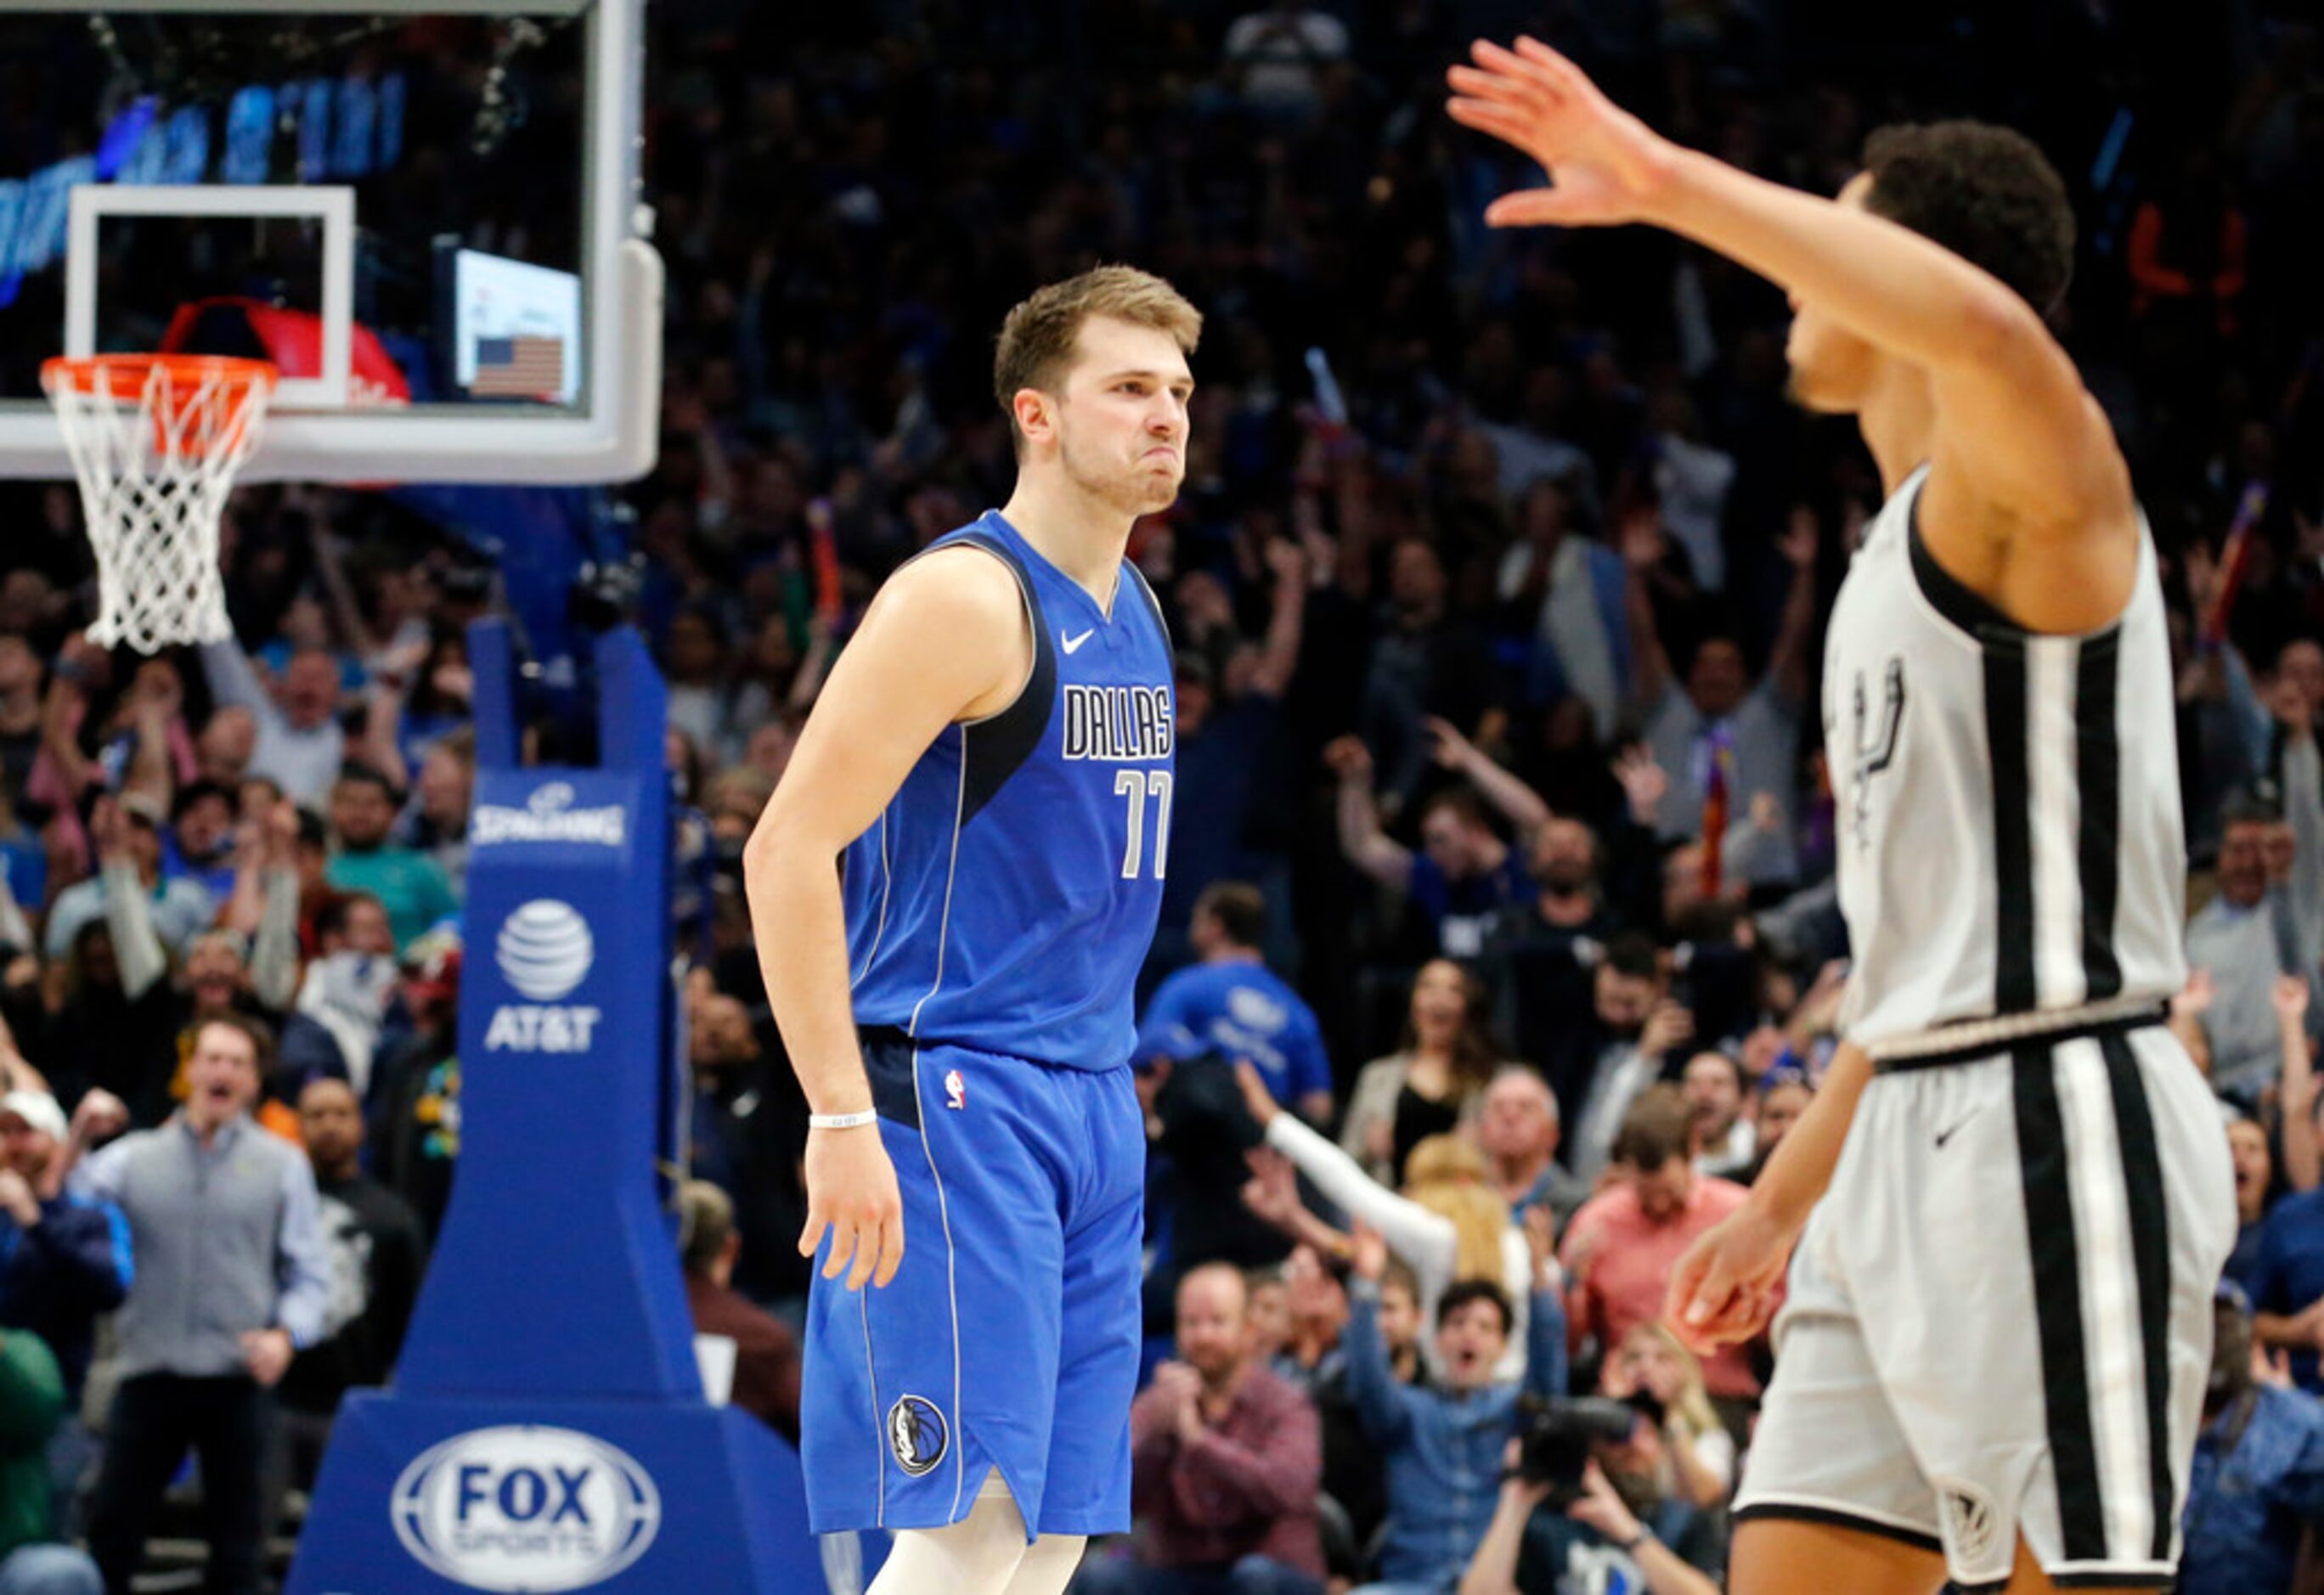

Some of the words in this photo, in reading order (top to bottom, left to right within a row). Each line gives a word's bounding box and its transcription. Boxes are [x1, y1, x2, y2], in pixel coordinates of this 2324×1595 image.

[1063, 685, 1172, 760] DALLAS
[471, 805, 624, 845] SPALDING
[1114, 769, 1173, 879] 77
[484, 1006, 601, 1052] AT&T
[459, 1467, 589, 1523] FOX
